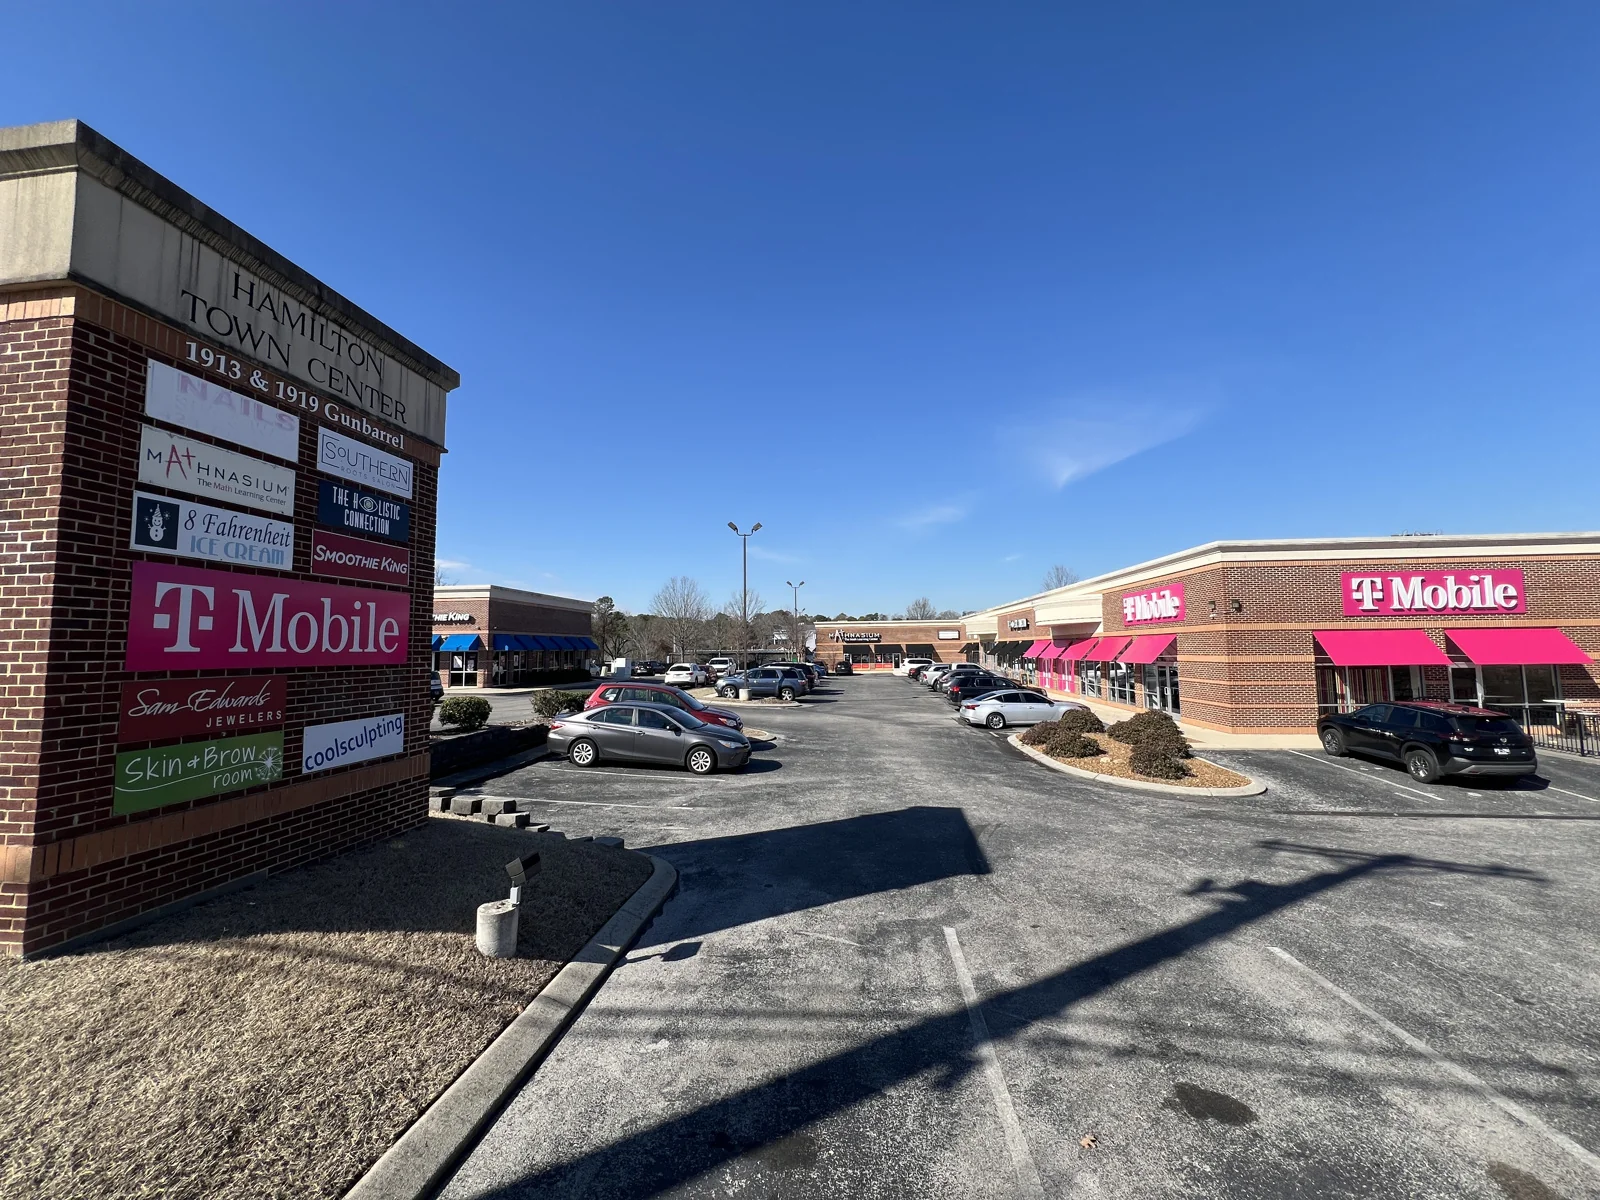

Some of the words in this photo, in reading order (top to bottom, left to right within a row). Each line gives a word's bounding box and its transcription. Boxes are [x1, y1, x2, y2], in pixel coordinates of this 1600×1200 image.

[232, 271, 383, 380] HAMILTON
[181, 289, 291, 369] TOWN
[307, 357, 407, 425] CENTER
[178, 373, 296, 432] NAILS
[185, 341, 242, 380] 1913
[249, 369, 269, 392] &
[275, 381, 319, 413] 1919
[324, 403, 405, 450] Gunbarrel
[197, 477, 212, 488] The
[213, 482, 233, 493] Math
[234, 487, 264, 502] Learning
[265, 495, 286, 506] Center
[341, 466, 368, 480] ROOTS
[372, 476, 395, 489] SALON
[332, 486, 349, 507] THE
[184, 509, 197, 531] 8
[202, 513, 291, 548] Fahrenheit
[344, 508, 390, 535] CONNECTION
[190, 535, 220, 557] ICE
[223, 541, 285, 566] CREAM
[313, 544, 380, 570] SMOOTHIE
[1134, 589, 1180, 622] Mobile
[1388, 574, 1518, 611] Mobile
[228, 588, 400, 654] Mobile
[127, 688, 185, 717] Sam
[187, 679, 272, 711] Edwards
[206, 709, 283, 728] JEWELERS
[304, 715, 403, 771] coolsculpting
[125, 753, 182, 784] Skin
[203, 745, 257, 770] Brow
[213, 766, 253, 788] room
